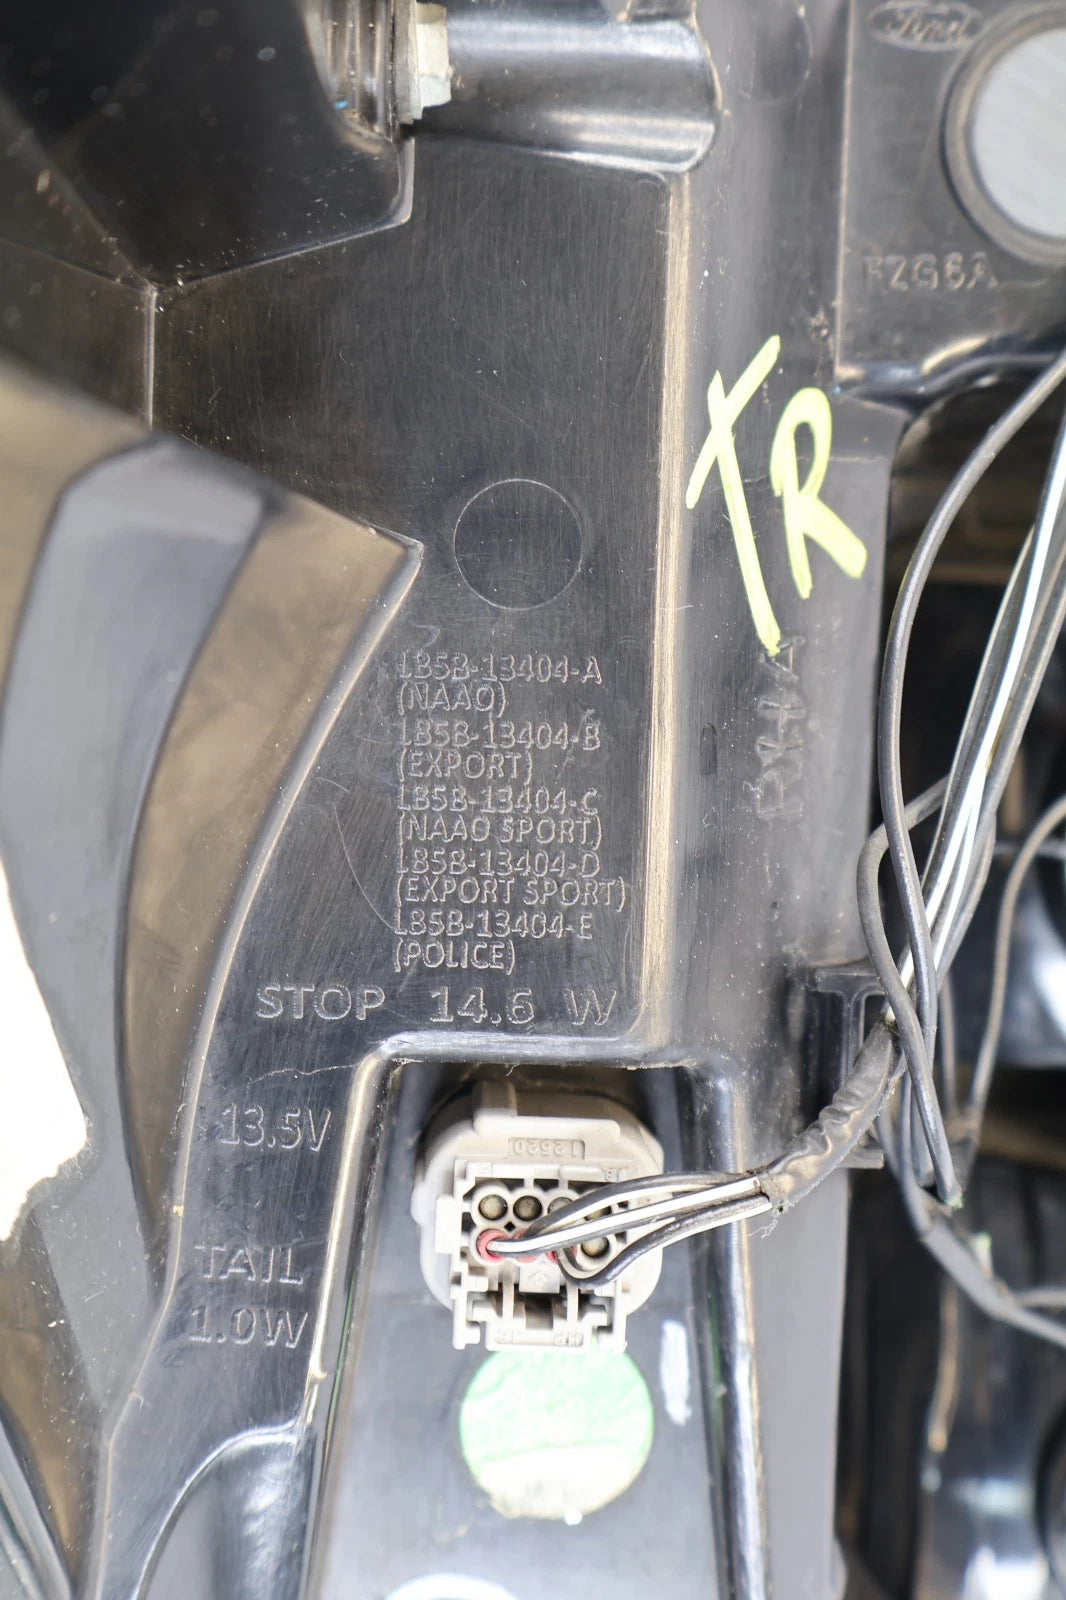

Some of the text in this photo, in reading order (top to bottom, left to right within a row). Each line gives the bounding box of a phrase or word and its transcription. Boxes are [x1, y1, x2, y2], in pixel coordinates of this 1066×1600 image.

[399, 650, 603, 684] LB5B-13404-A
[397, 680, 507, 718] (NAAO)
[398, 716, 601, 751] LB5B-13404-B
[397, 749, 533, 786] (EXPORT)
[397, 784, 599, 816] LB5B-13404-C
[499, 815, 602, 850] SPORT)
[395, 847, 601, 878] LB5B-13404-D
[396, 873, 626, 913] (EXPORT SPORT)
[394, 907, 593, 940] LB5B-13404-E
[395, 937, 516, 975] (POLICE)
[255, 983, 618, 1026] STOP 14.6 W
[219, 1103, 332, 1152] 13.5V
[194, 1245, 304, 1286] TAIL
[188, 1305, 308, 1349] 1.0W
